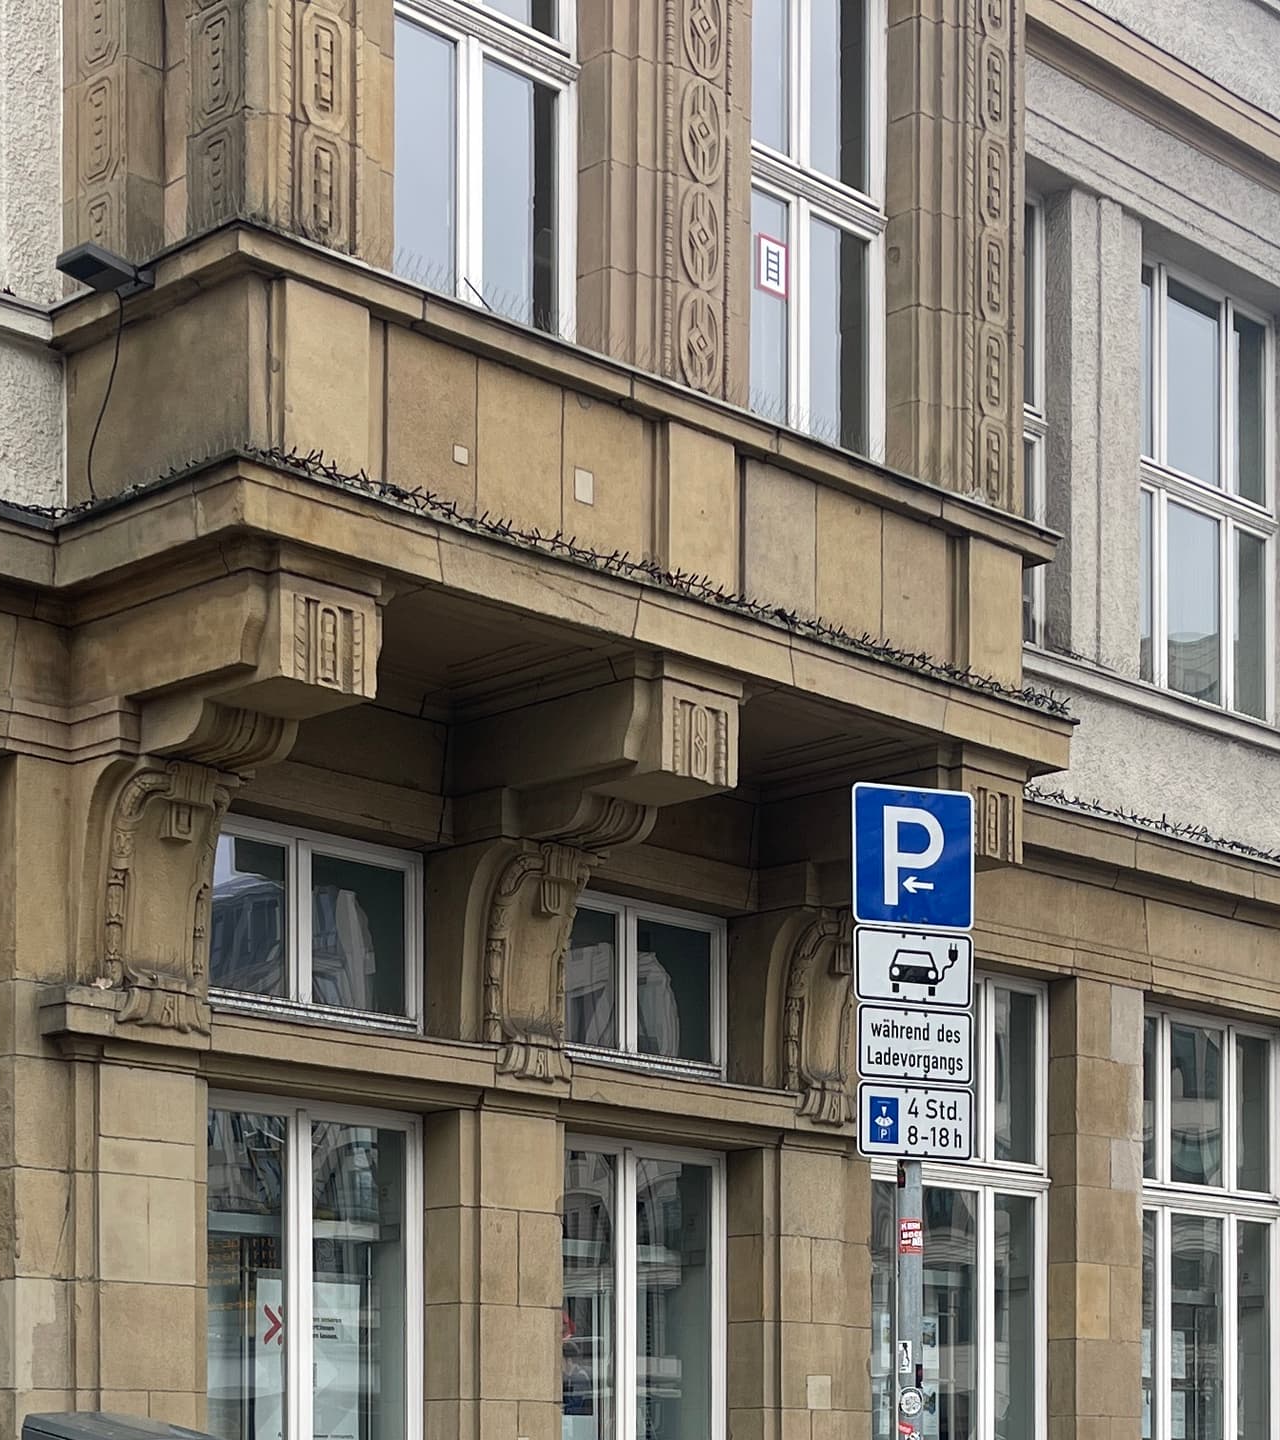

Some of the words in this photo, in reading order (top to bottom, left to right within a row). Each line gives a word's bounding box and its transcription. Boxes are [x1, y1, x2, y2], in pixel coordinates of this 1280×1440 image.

[883, 805, 945, 905] P
[871, 1019, 930, 1043] während
[937, 1023, 961, 1044] des
[867, 1045, 963, 1074] Ladevorgangs
[907, 1097, 919, 1119] 4
[926, 1099, 963, 1121] Std.
